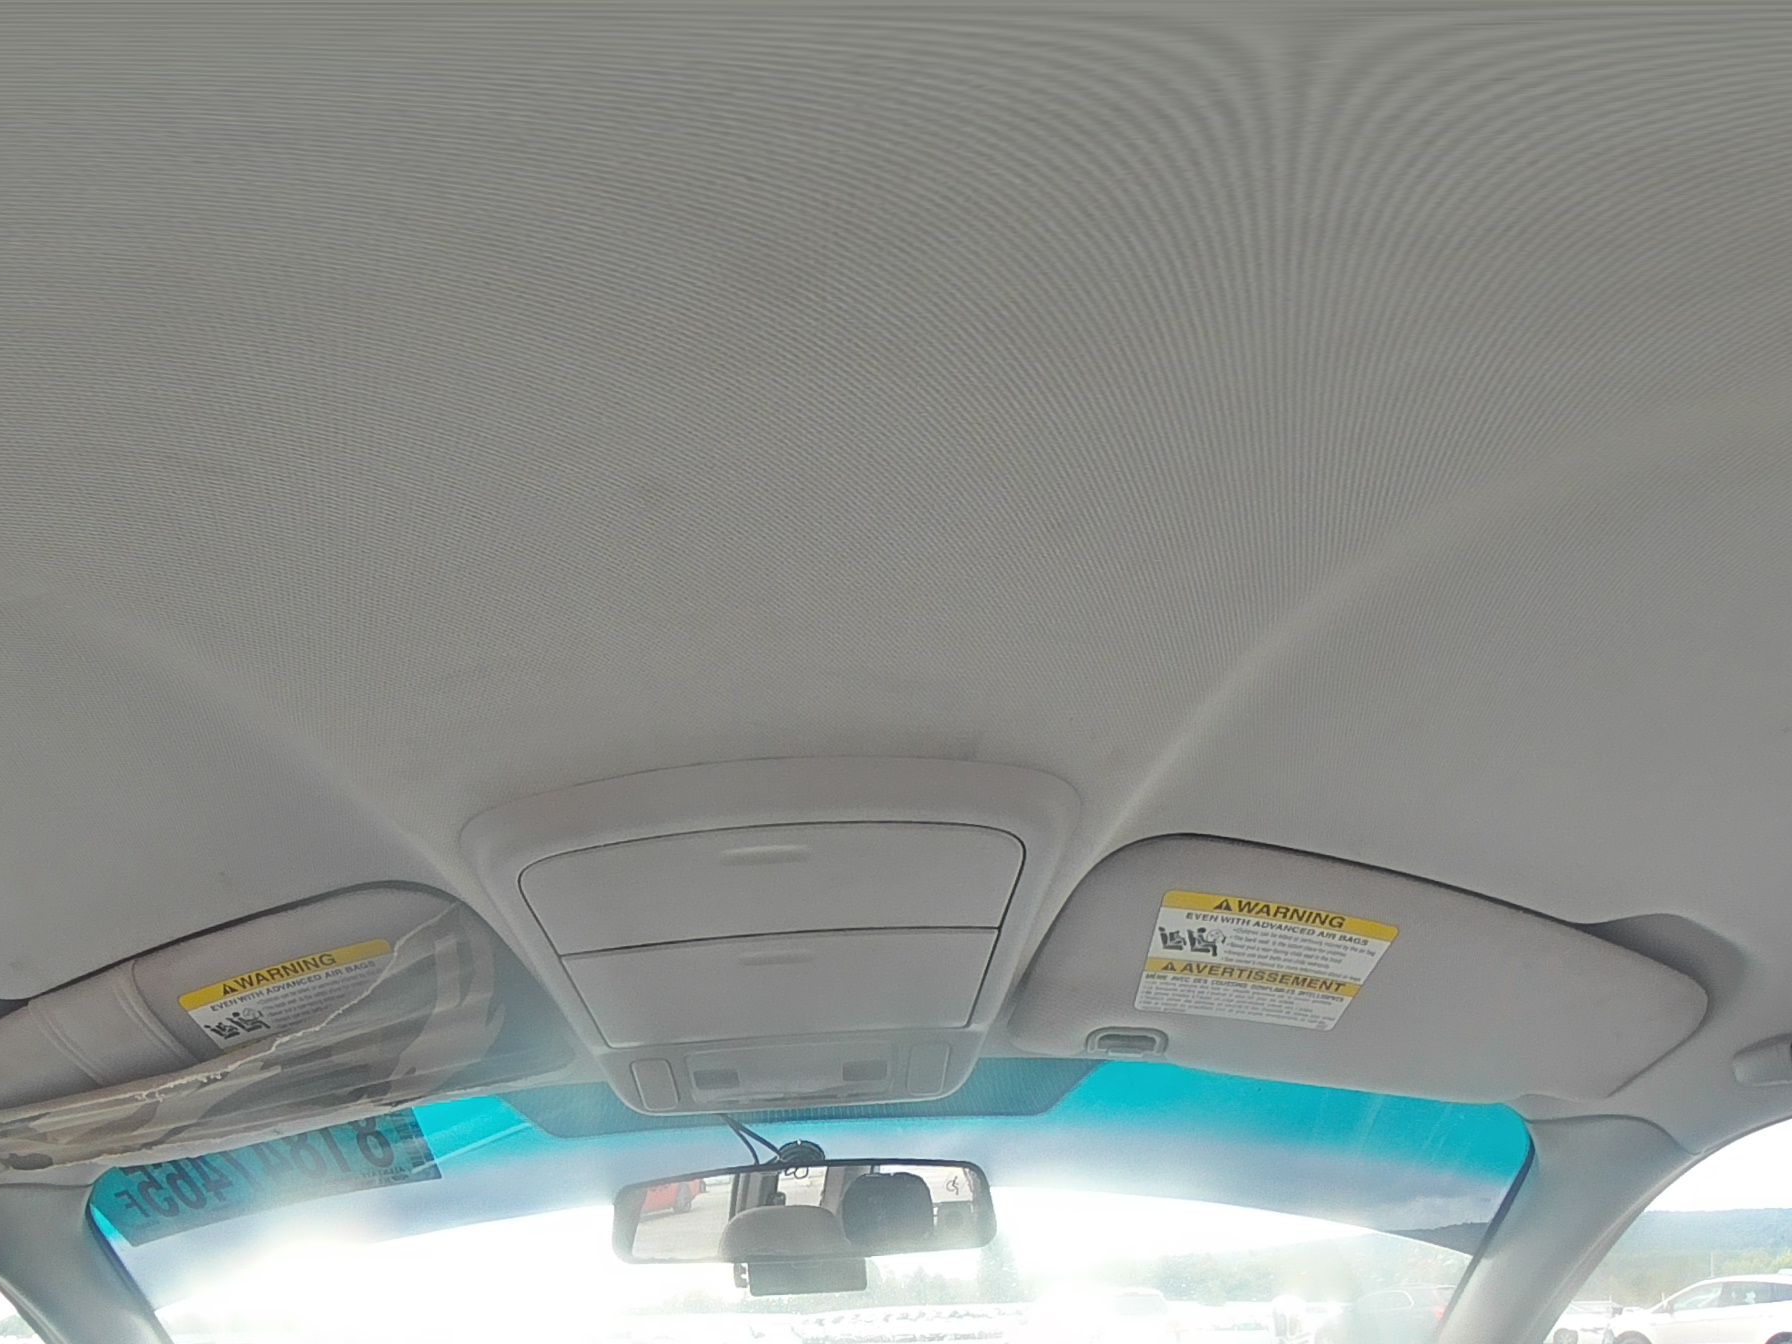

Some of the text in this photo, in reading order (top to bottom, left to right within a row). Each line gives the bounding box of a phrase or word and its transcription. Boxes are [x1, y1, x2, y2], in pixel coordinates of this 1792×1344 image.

[1185, 912, 1219, 922] EVEN
[1221, 915, 1251, 927] WITH
[1252, 920, 1315, 936] ADVANCED
[1317, 930, 1336, 940] AIR
[1338, 934, 1369, 946] BAGS
[1238, 899, 1345, 928] WARNING
[210, 960, 376, 1012] EVEN WITH ADVANCED AIR BAGS
[233, 953, 336, 989] WARNING
[1180, 963, 1346, 992] AVERTISSEMENT
